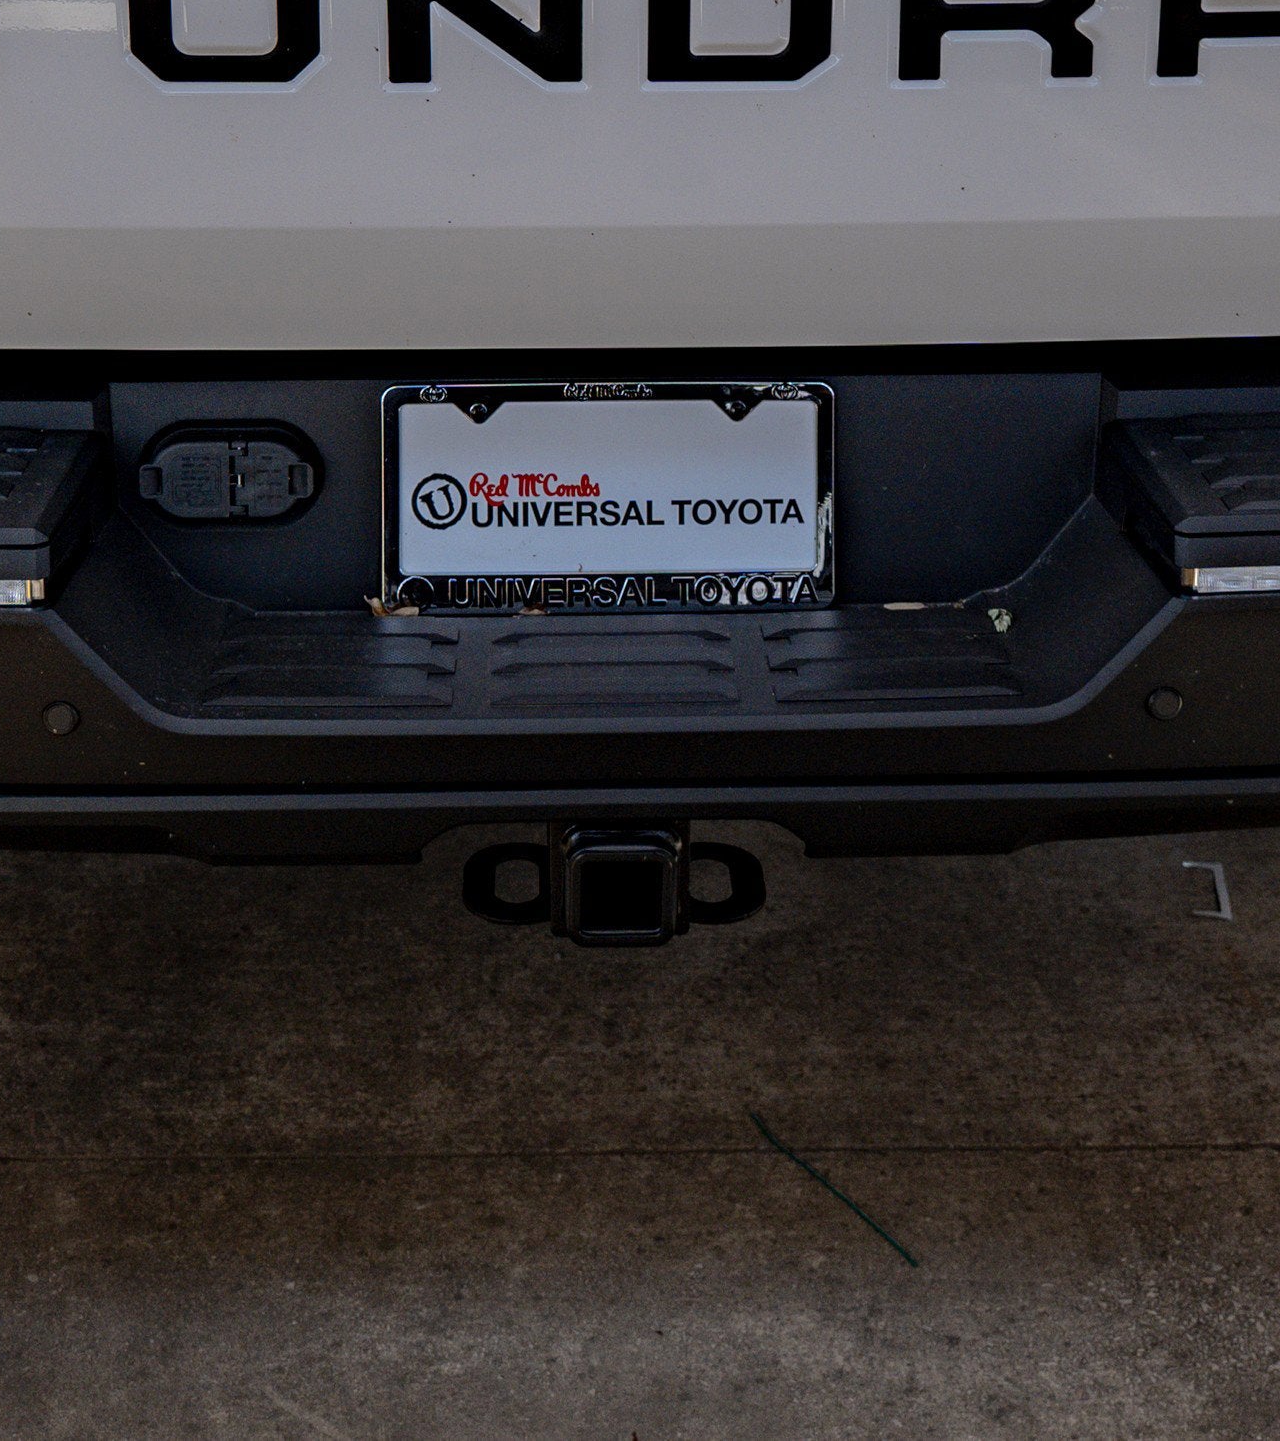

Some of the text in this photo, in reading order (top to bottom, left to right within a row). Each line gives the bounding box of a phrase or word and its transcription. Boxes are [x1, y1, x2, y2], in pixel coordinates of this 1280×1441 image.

[469, 472, 600, 506] Red McCombs
[471, 498, 805, 528] UNIVERSAL TOYOTA
[448, 574, 820, 609] UNIVERSAL TOYOTA
